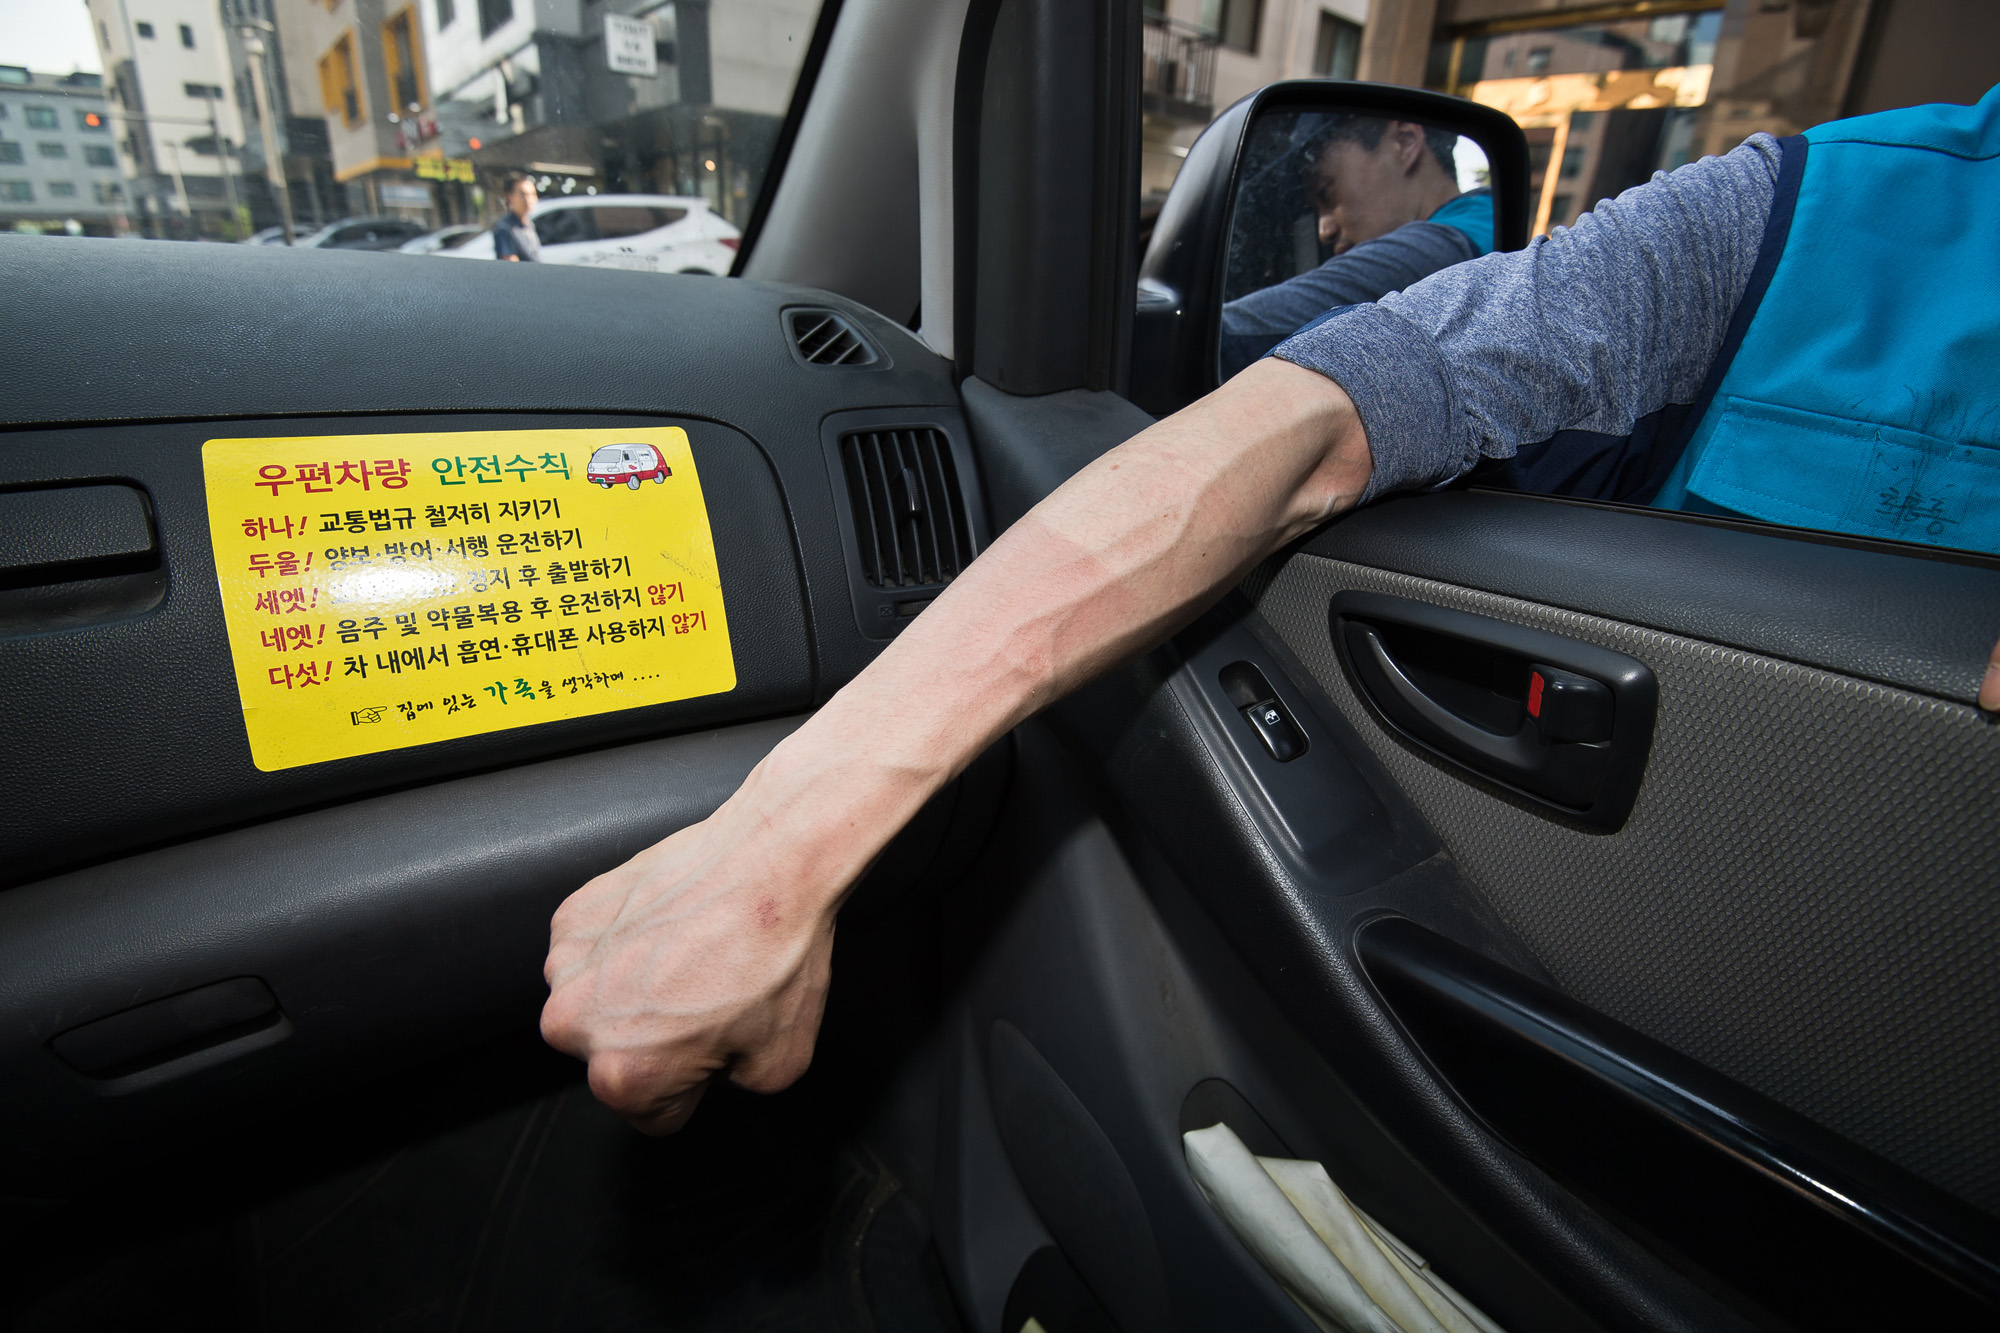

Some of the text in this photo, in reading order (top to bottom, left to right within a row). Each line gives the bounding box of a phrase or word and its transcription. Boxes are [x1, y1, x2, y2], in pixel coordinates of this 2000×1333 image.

[255, 452, 570, 496] 우편차량 안전수칙
[242, 498, 560, 541] 하나! 교통법규 철저히 지키기
[248, 551, 313, 578] 두울!
[496, 528, 582, 555] 운전하기
[255, 587, 318, 615] 세엣!
[467, 567, 510, 593] 정지
[518, 564, 540, 587] 후
[547, 556, 631, 585] 출발하기
[260, 581, 685, 651] 네엣! 음주 및 약물복용 후 운전하지 않기
[268, 610, 707, 689] 다섯! 차 내에서 흡연·휴대폰 사용하지 않기
[396, 700, 433, 721] 집에
[443, 694, 477, 715] 있는
[562, 671, 624, 694] 생각하며
